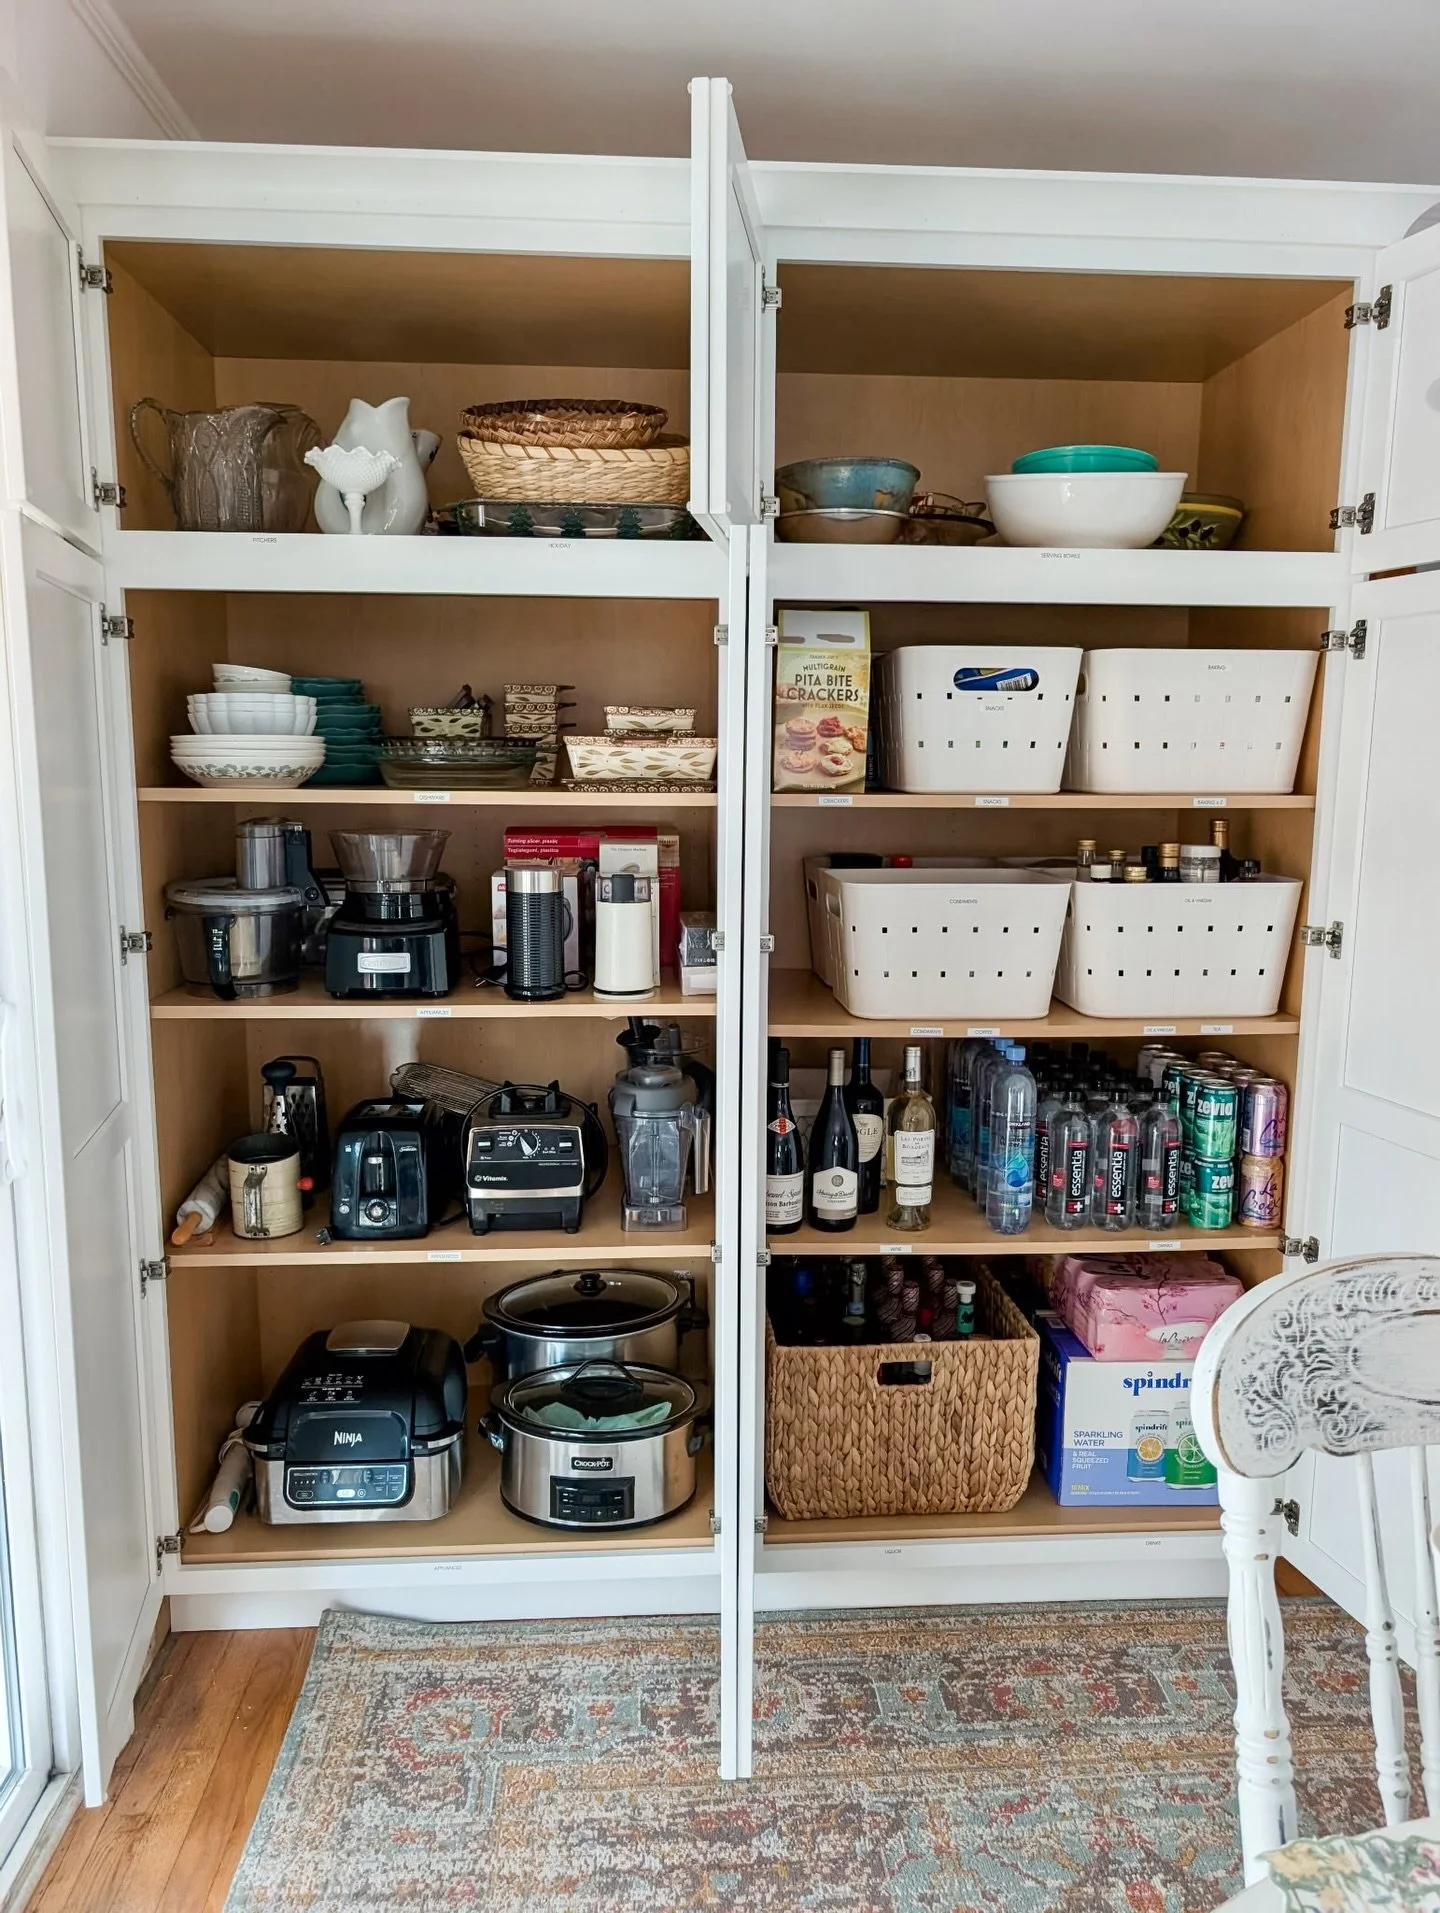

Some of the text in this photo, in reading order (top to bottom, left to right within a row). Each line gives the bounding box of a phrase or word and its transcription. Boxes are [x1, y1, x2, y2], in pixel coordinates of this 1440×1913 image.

[803, 663, 846, 671] MULTIGRAIN
[795, 674, 852, 687] PITA BITE
[787, 687, 859, 702] CRACKERS
[1197, 1098, 1233, 1115] zevia
[1039, 1135, 1050, 1182] essentia
[1071, 1149, 1083, 1197] essentia
[1111, 1151, 1124, 1198] essentia
[1167, 1149, 1178, 1197] essentia
[1211, 1175, 1234, 1190] zev
[1123, 1370, 1192, 1396] spindr
[1073, 1430, 1123, 1439] SPARKLING
[1135, 1423, 1168, 1433] spindrift
[333, 1431, 362, 1447] NINJA
[1073, 1439, 1105, 1447] WATER
